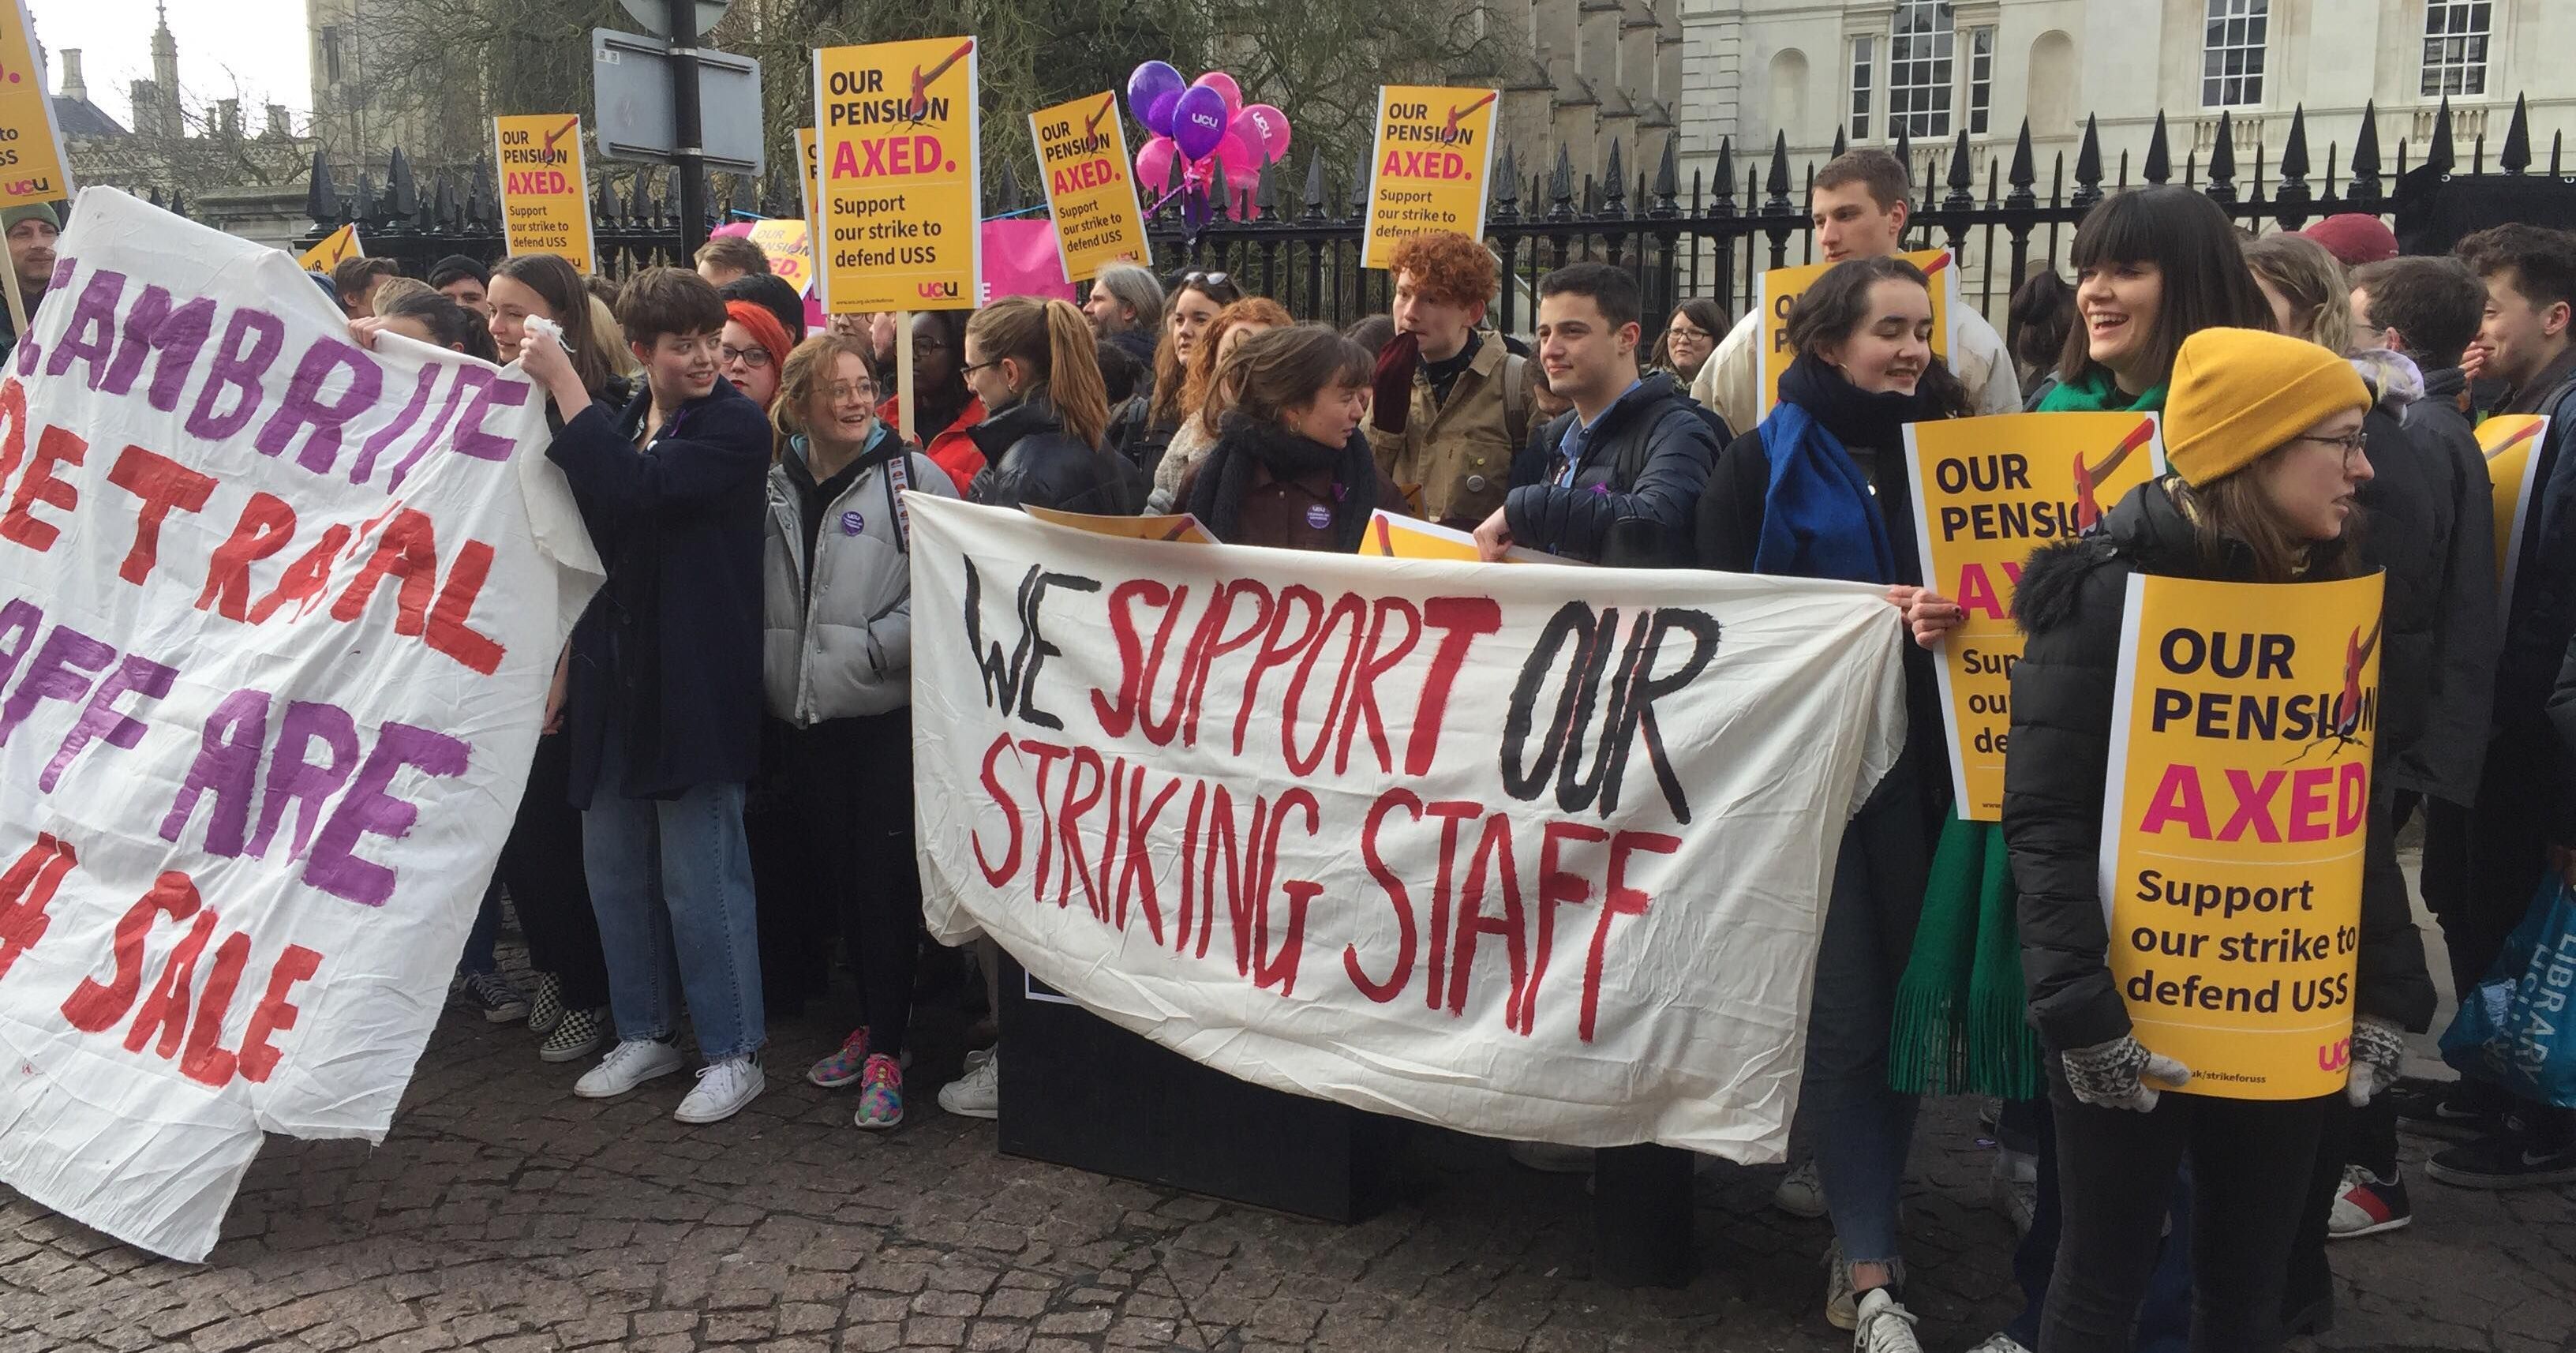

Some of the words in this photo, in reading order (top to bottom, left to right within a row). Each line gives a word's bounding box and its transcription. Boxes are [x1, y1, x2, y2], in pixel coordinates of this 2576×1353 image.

[829, 69, 884, 96] OUR
[830, 96, 949, 127] PENSION
[1389, 103, 1428, 121] OUR
[502, 130, 530, 145] OUR
[1041, 121, 1072, 143] OUR
[1386, 124, 1474, 146] PENSION
[504, 148, 567, 164] PENSION
[831, 135, 957, 180] AXED.
[1045, 133, 1110, 163] PENSION
[1054, 158, 1121, 197] AXED.
[1382, 150, 1473, 182] AXED.
[507, 171, 575, 196] AXED.
[833, 194, 906, 218] Support
[1059, 199, 1099, 219] Support
[1380, 189, 1432, 205] Support
[509, 205, 548, 219] Support
[1063, 223, 1079, 236] our
[1081, 216, 1109, 233] strike
[1110, 212, 1122, 225] to
[1377, 209, 1399, 219] our
[1402, 208, 1439, 223] strike
[1442, 210, 1456, 223] to
[511, 223, 526, 232] our
[528, 220, 556, 232] strike
[557, 221, 569, 231] to
[756, 229, 786, 240] OUR
[834, 226, 865, 242] our
[868, 220, 919, 240] strike
[923, 220, 942, 237] to
[1376, 224, 1421, 238] defend
[513, 236, 545, 248] defend
[546, 237, 567, 248] USS
[1067, 236, 1100, 253] defend
[1101, 229, 1123, 245] USS
[835, 246, 896, 268] defend
[900, 245, 937, 264] USS
[1935, 453, 2033, 495] OUR
[2159, 627, 2296, 680] OUR
[962, 553, 1102, 732] WE
[1091, 578, 1502, 778] SUPPORT
[1500, 599, 1721, 826] OUR
[2151, 686, 2376, 741] PENSION
[159, 688, 473, 907] ARE
[972, 731, 1324, 999] STRIKING
[1342, 786, 1682, 1045] STAFF
[2136, 869, 2314, 919] Support
[2131, 924, 2209, 959] our
[2218, 928, 2330, 963] strike
[2336, 924, 2356, 956] to
[60, 870, 325, 1089] SALE
[2126, 969, 2280, 1014] defend
[2292, 972, 2349, 1012] USS
